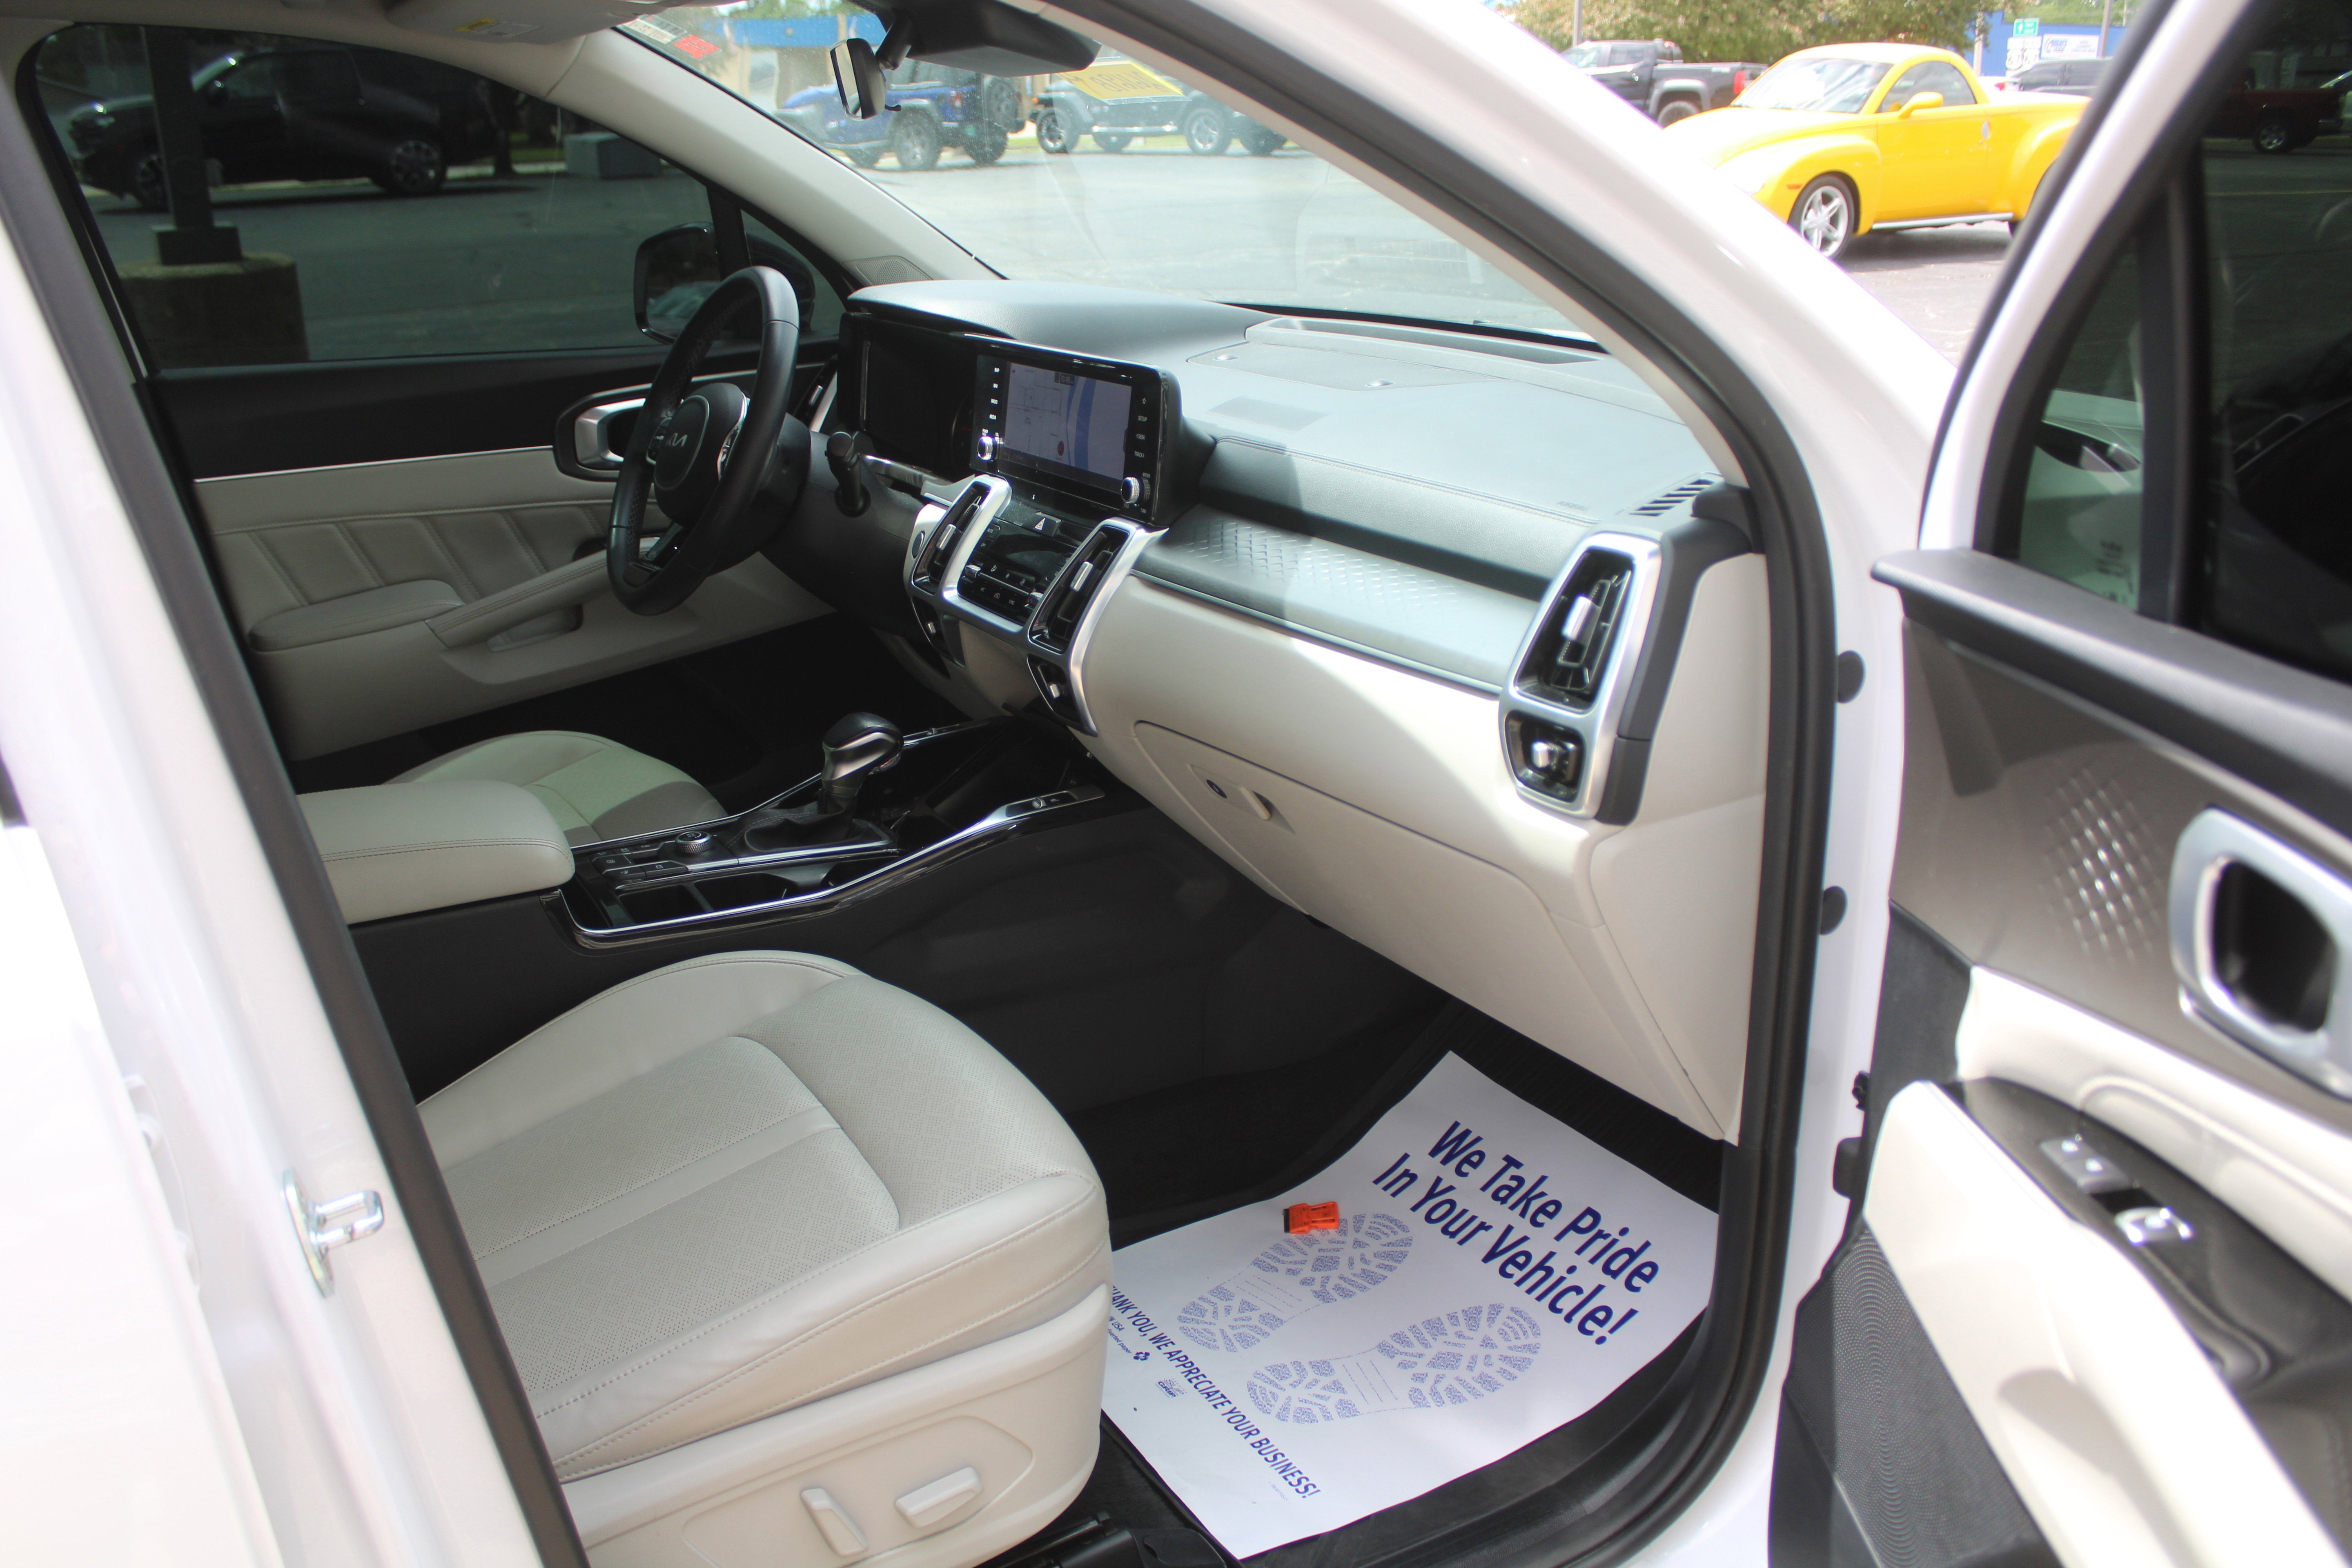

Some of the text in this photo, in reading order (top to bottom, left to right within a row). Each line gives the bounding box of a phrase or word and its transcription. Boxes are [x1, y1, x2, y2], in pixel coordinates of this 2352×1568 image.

[1557, 500, 1591, 512] AIRBAG
[1428, 1120, 1659, 1293] We Take Pride
[1372, 1152, 1639, 1345] In Your Vehicle!
[1111, 1321, 1125, 1332] USA
[1118, 1343, 1132, 1354] paper
[1112, 1285, 1138, 1314] ANK
[1127, 1311, 1158, 1337] YOU,
[1149, 1332, 1176, 1350] WE
[1163, 1350, 1232, 1410] APPRECIATE
[1221, 1406, 1261, 1440] YOUR
[1250, 1437, 1321, 1499] BUSINESS!
[1158, 1381, 1176, 1397] GRIP
